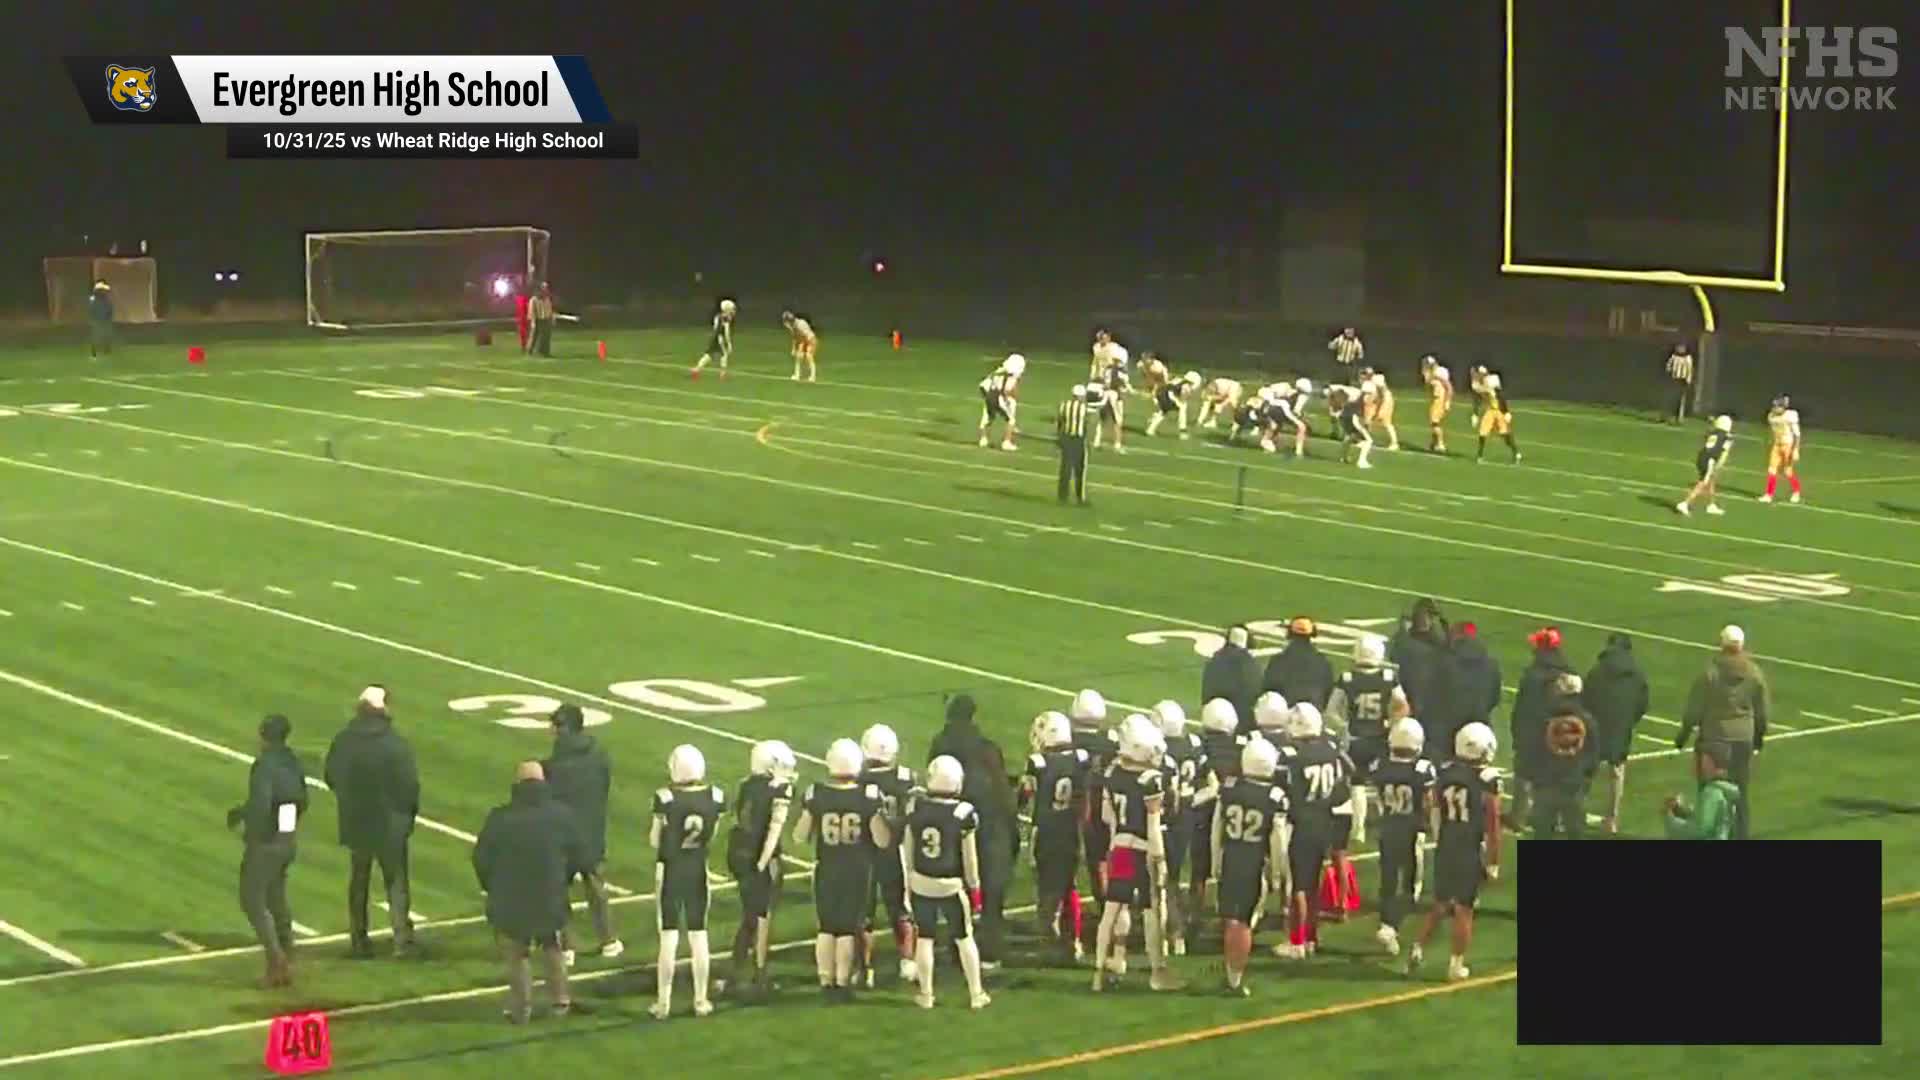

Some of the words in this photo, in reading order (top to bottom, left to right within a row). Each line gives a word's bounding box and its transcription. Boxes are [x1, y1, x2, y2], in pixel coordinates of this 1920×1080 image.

[1655, 572, 1851, 601] 10
[447, 678, 767, 729] 30
[1353, 692, 1383, 721] 15
[1052, 777, 1073, 812] 9
[1304, 763, 1335, 801] 70
[1443, 784, 1470, 823] 11
[681, 814, 704, 849] 2
[821, 812, 862, 847] 66
[1225, 804, 1264, 843] 32
[921, 826, 942, 859] 3
[282, 1021, 322, 1058] 40
